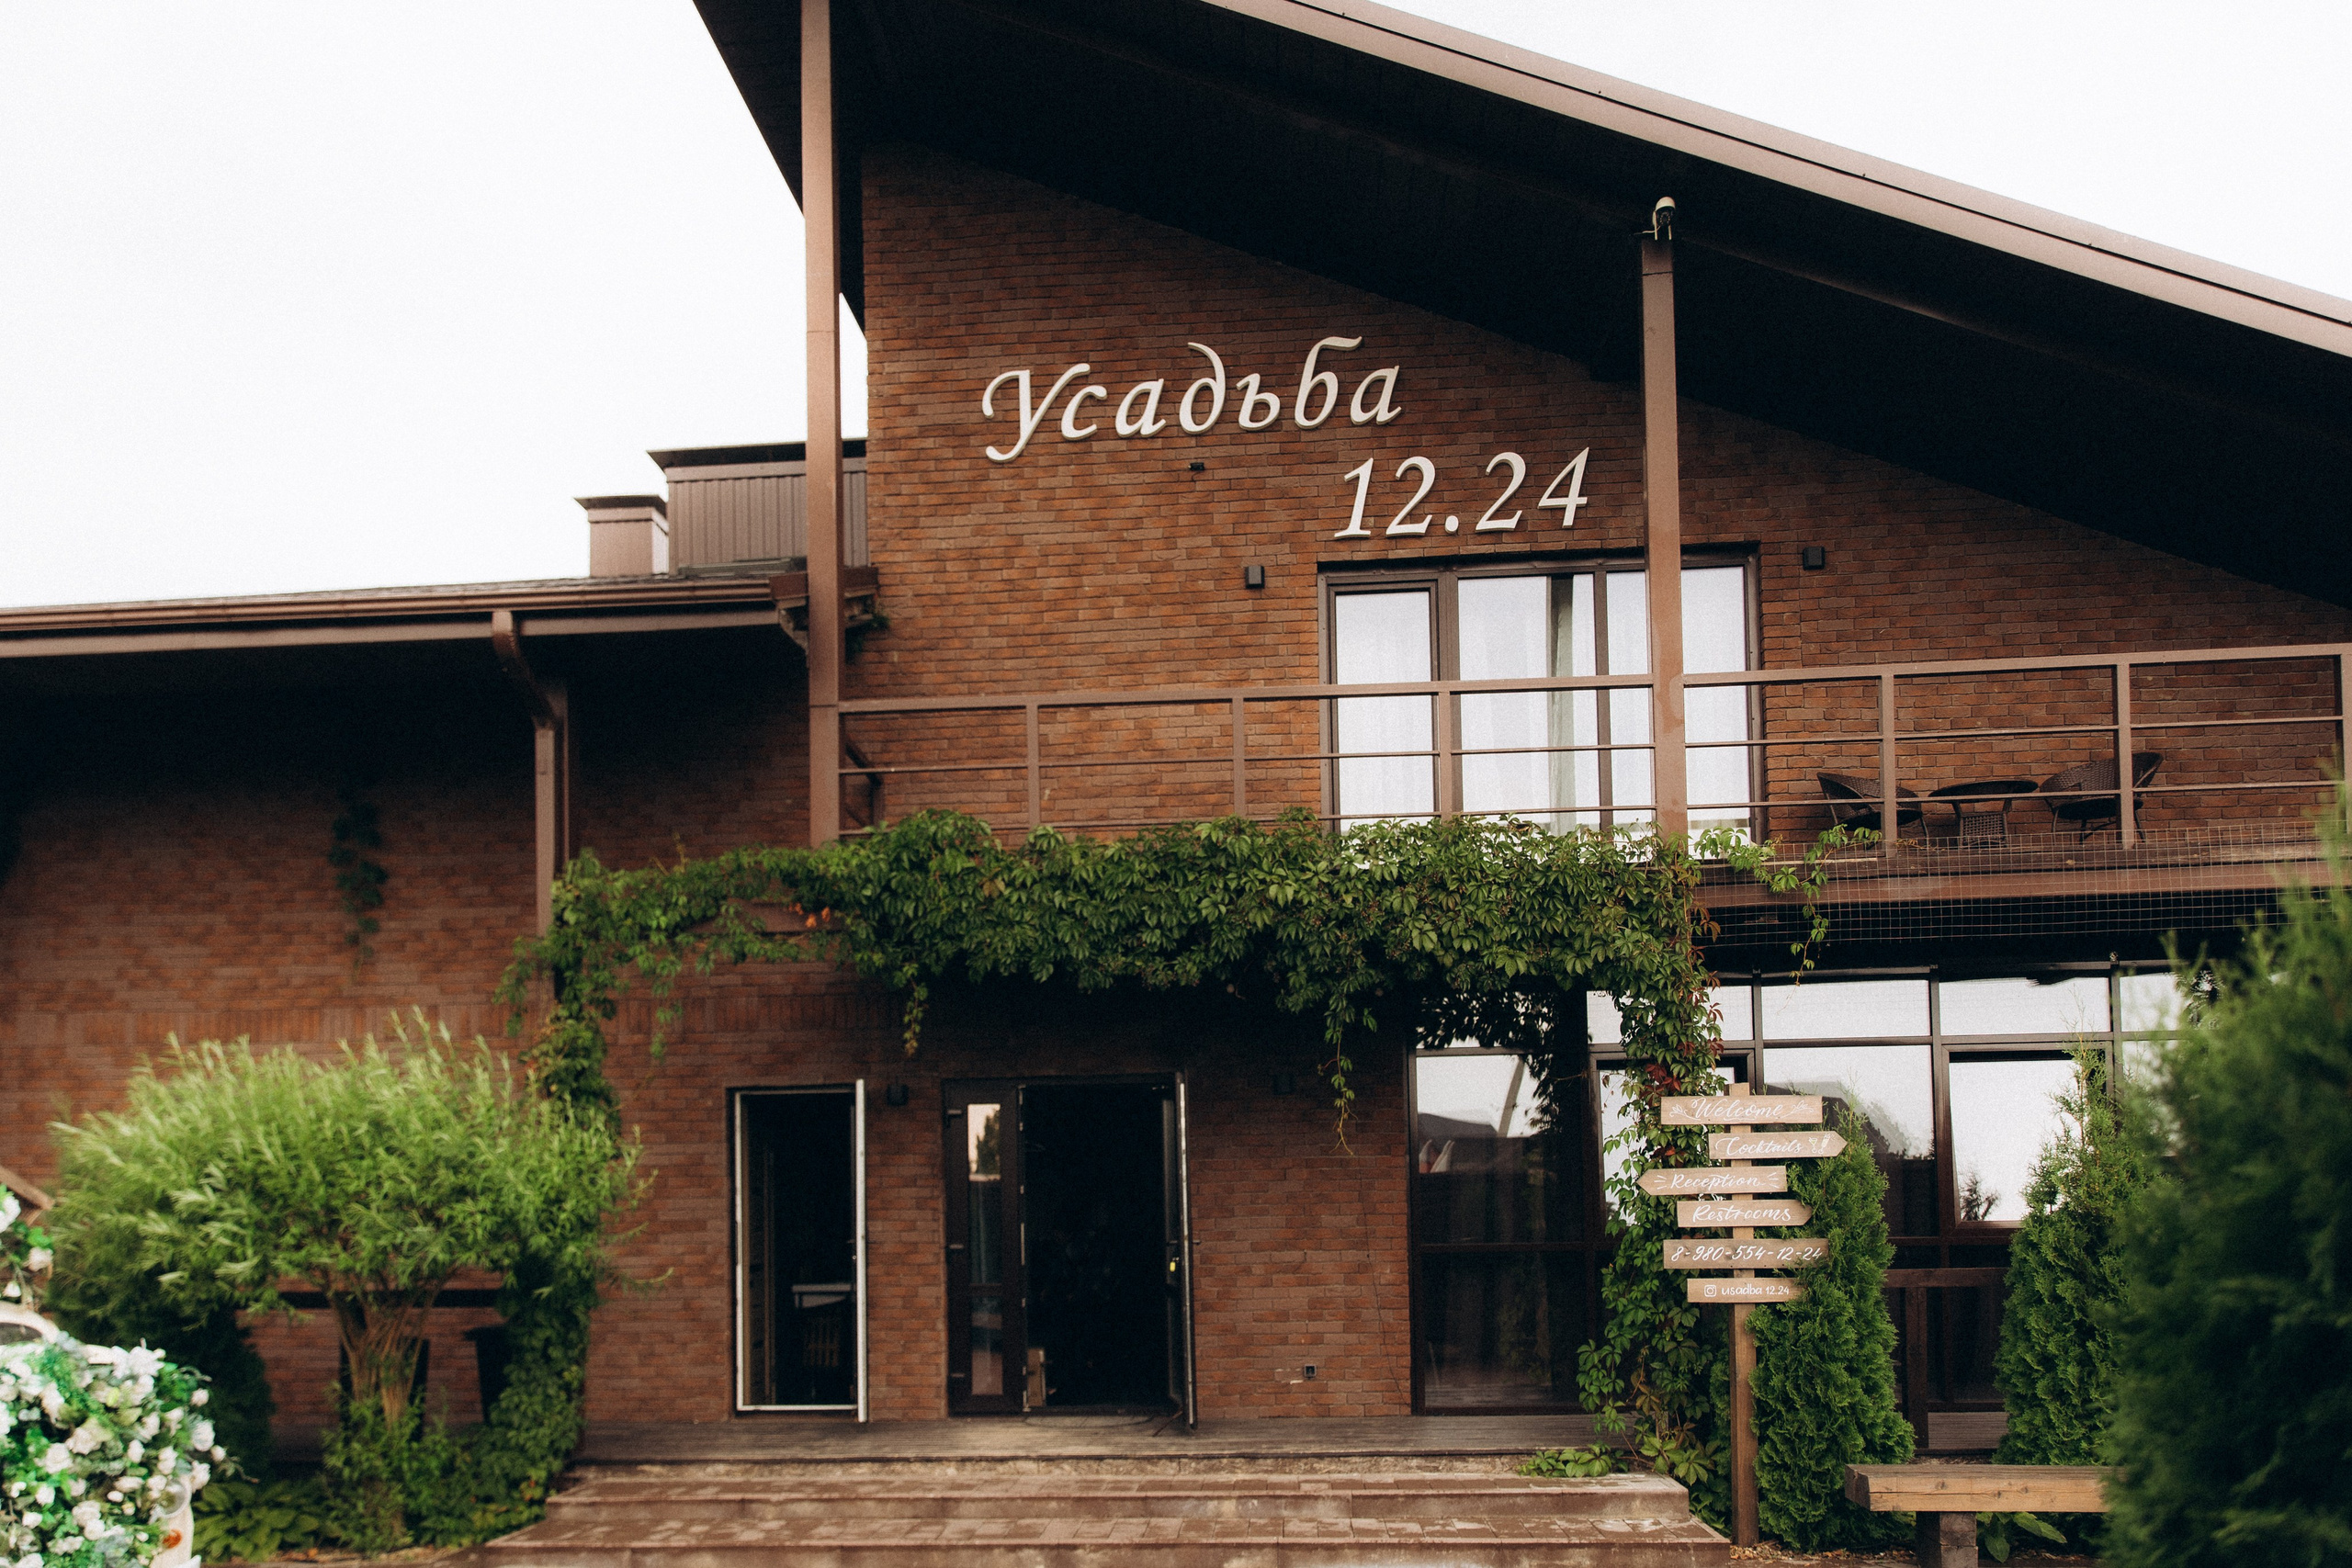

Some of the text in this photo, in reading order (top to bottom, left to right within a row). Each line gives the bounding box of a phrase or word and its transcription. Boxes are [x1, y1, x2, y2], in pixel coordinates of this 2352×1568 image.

[981, 335, 1401, 464] Усадьба
[1333, 447, 1589, 539] 12.24
[1690, 1098, 1784, 1119] Welcome
[1715, 1136, 1803, 1156] Cocktails
[1670, 1173, 1766, 1190] Reception
[1692, 1204, 1792, 1223] Restrooms
[1671, 1245, 1823, 1261] 8-980-554-12-24
[1722, 1283, 1790, 1295] usadba 12.24
